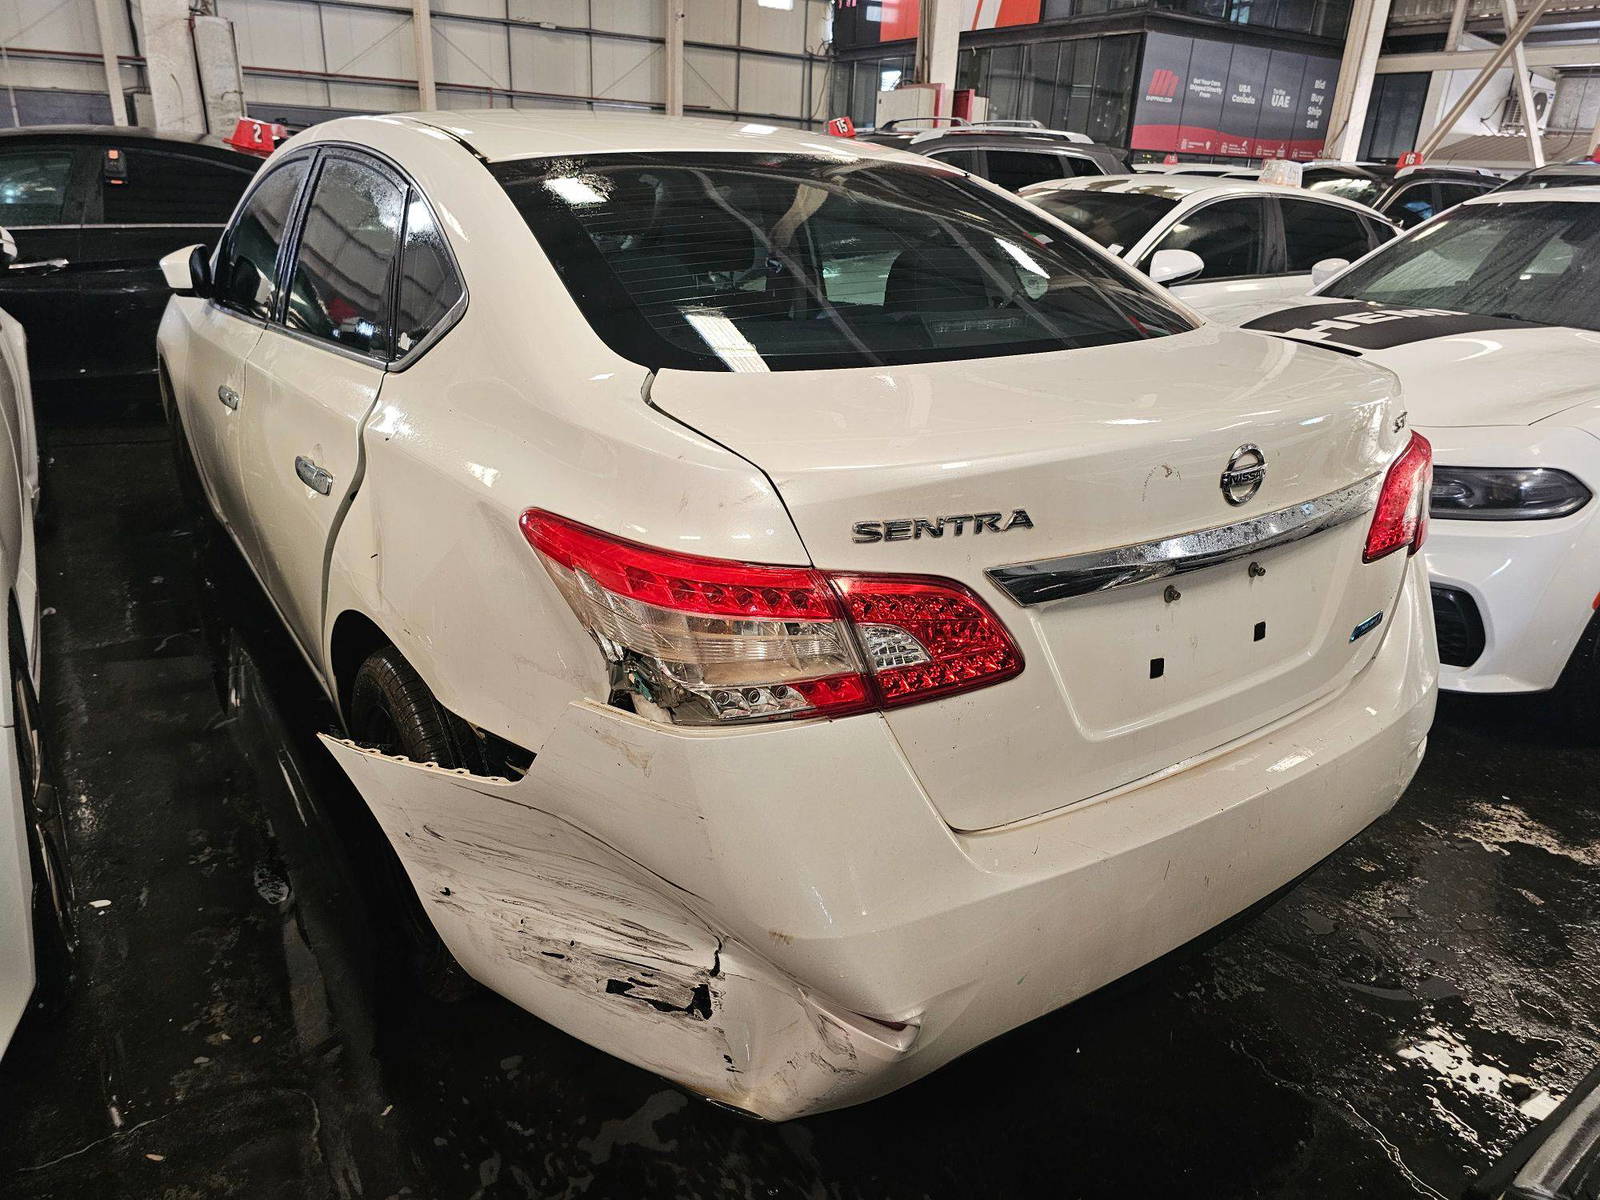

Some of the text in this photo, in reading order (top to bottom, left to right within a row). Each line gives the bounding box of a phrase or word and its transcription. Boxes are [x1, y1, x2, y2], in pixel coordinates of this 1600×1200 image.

[1239, 84, 1251, 93] USA
[1315, 79, 1326, 90] Bid
[1231, 95, 1256, 105] Canada
[1271, 94, 1291, 108] UAE
[1311, 93, 1325, 105] Buy
[1307, 106, 1322, 119] Ship
[836, 119, 848, 134] 15
[1306, 120, 1319, 129] Sell
[253, 123, 263, 143] 2
[1405, 153, 1415, 165] 16
[1281, 308, 1470, 341] HEMI
[1230, 467, 1266, 486] NISSAN
[852, 509, 1034, 544] SENTRA
